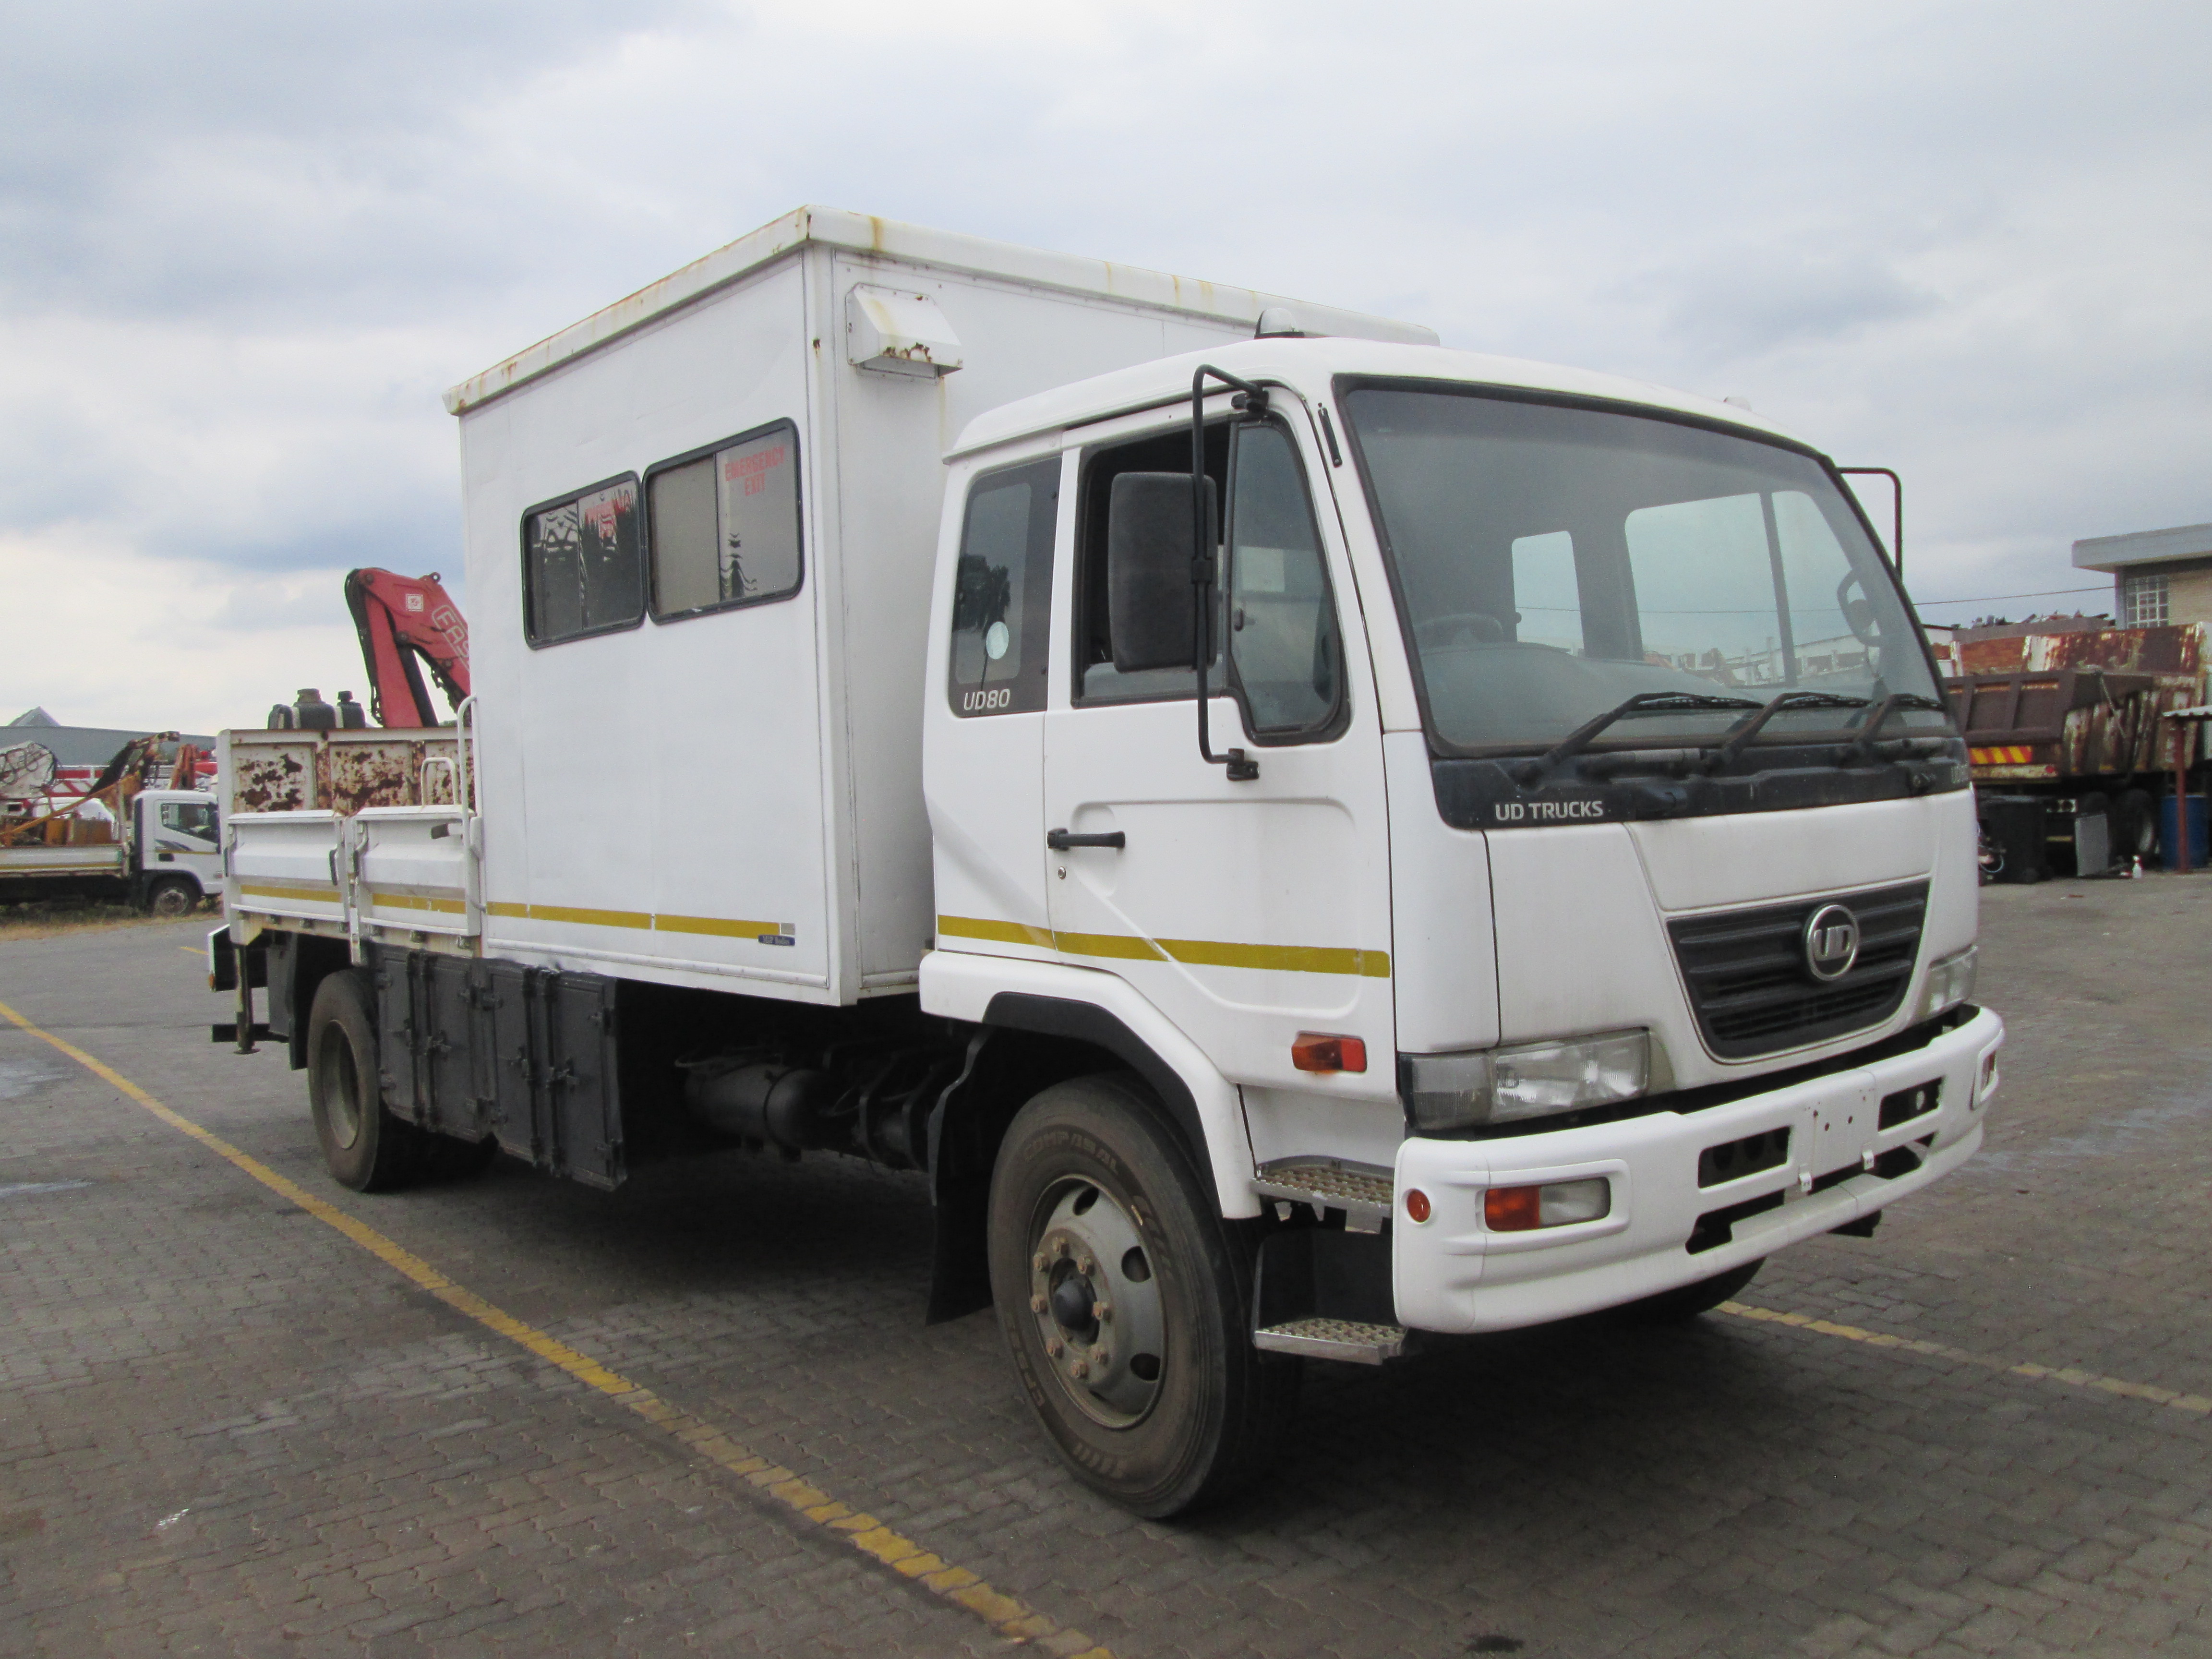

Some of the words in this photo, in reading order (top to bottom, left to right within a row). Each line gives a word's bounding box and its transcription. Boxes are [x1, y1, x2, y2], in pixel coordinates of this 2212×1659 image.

[725, 445, 785, 481] EMERGENCY
[745, 472, 766, 496] EXIT
[436, 611, 469, 664] FAS
[963, 688, 1011, 711] UD80
[1495, 803, 1525, 821] UD
[1528, 800, 1604, 819] TRUCKS
[1813, 923, 1855, 962] UD
